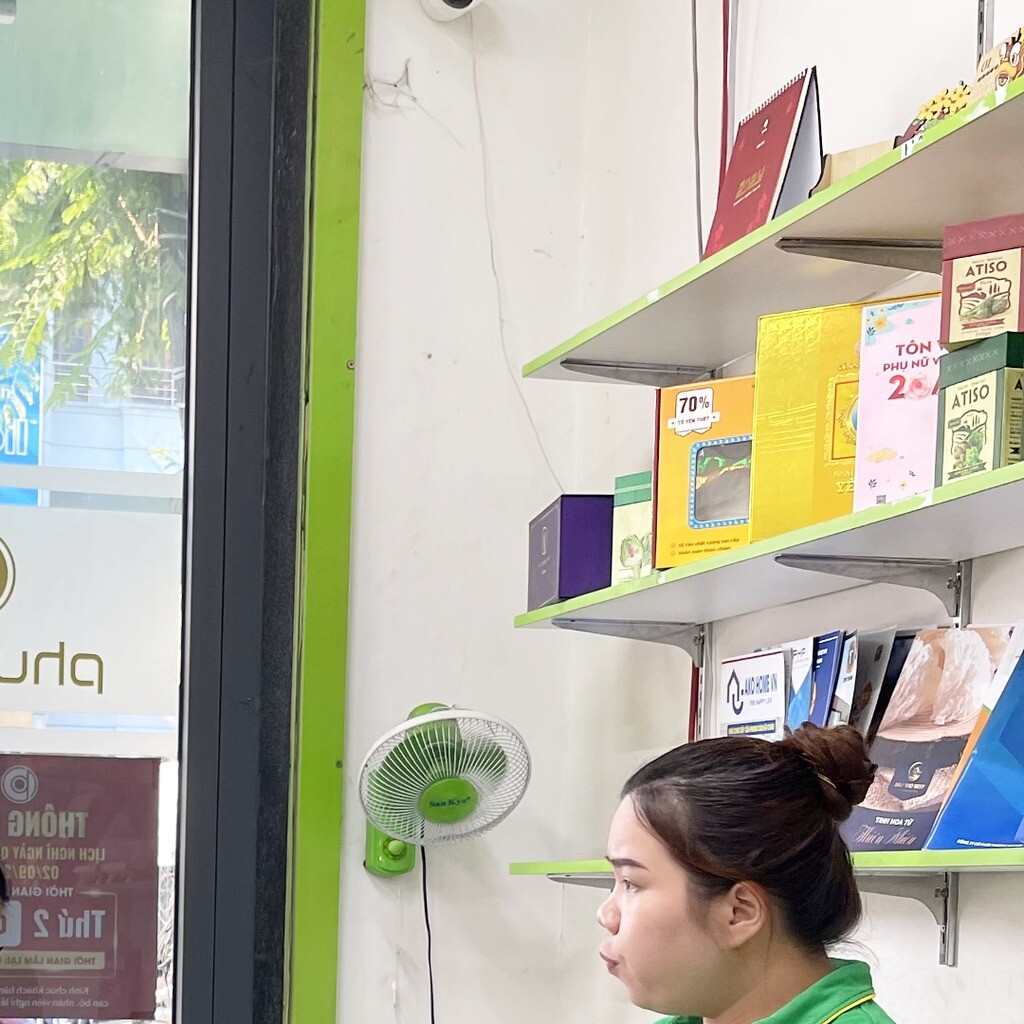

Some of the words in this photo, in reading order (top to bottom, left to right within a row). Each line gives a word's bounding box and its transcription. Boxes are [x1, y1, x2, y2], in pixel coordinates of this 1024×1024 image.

[965, 260, 1007, 277] ATISO
[896, 339, 932, 356] TÔN
[883, 361, 908, 373] PHỤ
[912, 356, 929, 369] NỮ
[679, 395, 710, 414] 70%
[952, 384, 990, 410] ATISO
